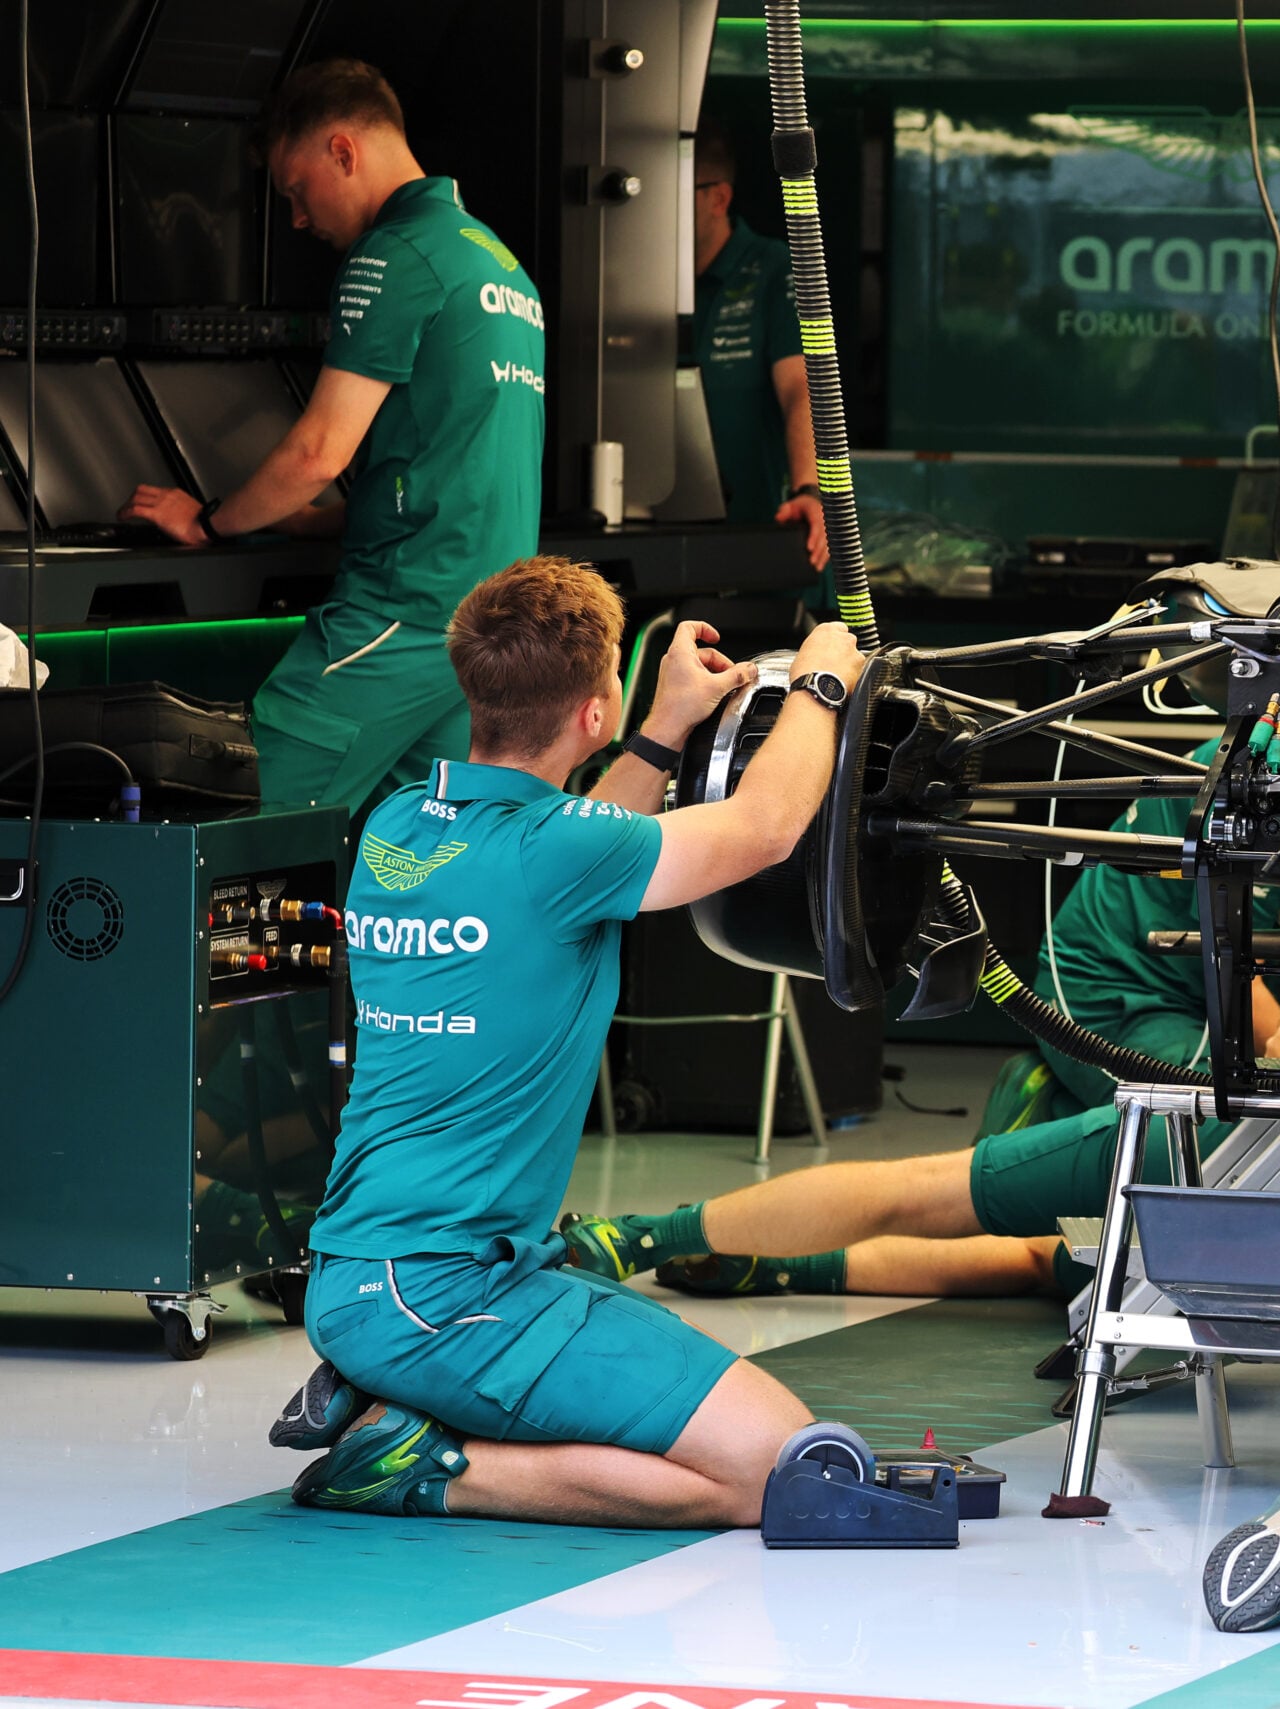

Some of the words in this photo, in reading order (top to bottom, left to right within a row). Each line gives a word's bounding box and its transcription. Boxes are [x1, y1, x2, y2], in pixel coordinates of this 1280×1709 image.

[1057, 310, 1206, 339] FORMULA
[421, 799, 458, 821] BOSS
[384, 855, 415, 873] ASTON
[213, 888, 229, 900] BLEED
[229, 885, 248, 896] RETURN
[265, 930, 278, 942] FEED
[345, 911, 489, 956] aramco
[210, 937, 229, 952] SYSTEM
[229, 935, 249, 948] RETURN
[366, 1004, 476, 1034] Honda
[359, 1281, 384, 1294] BOSS
